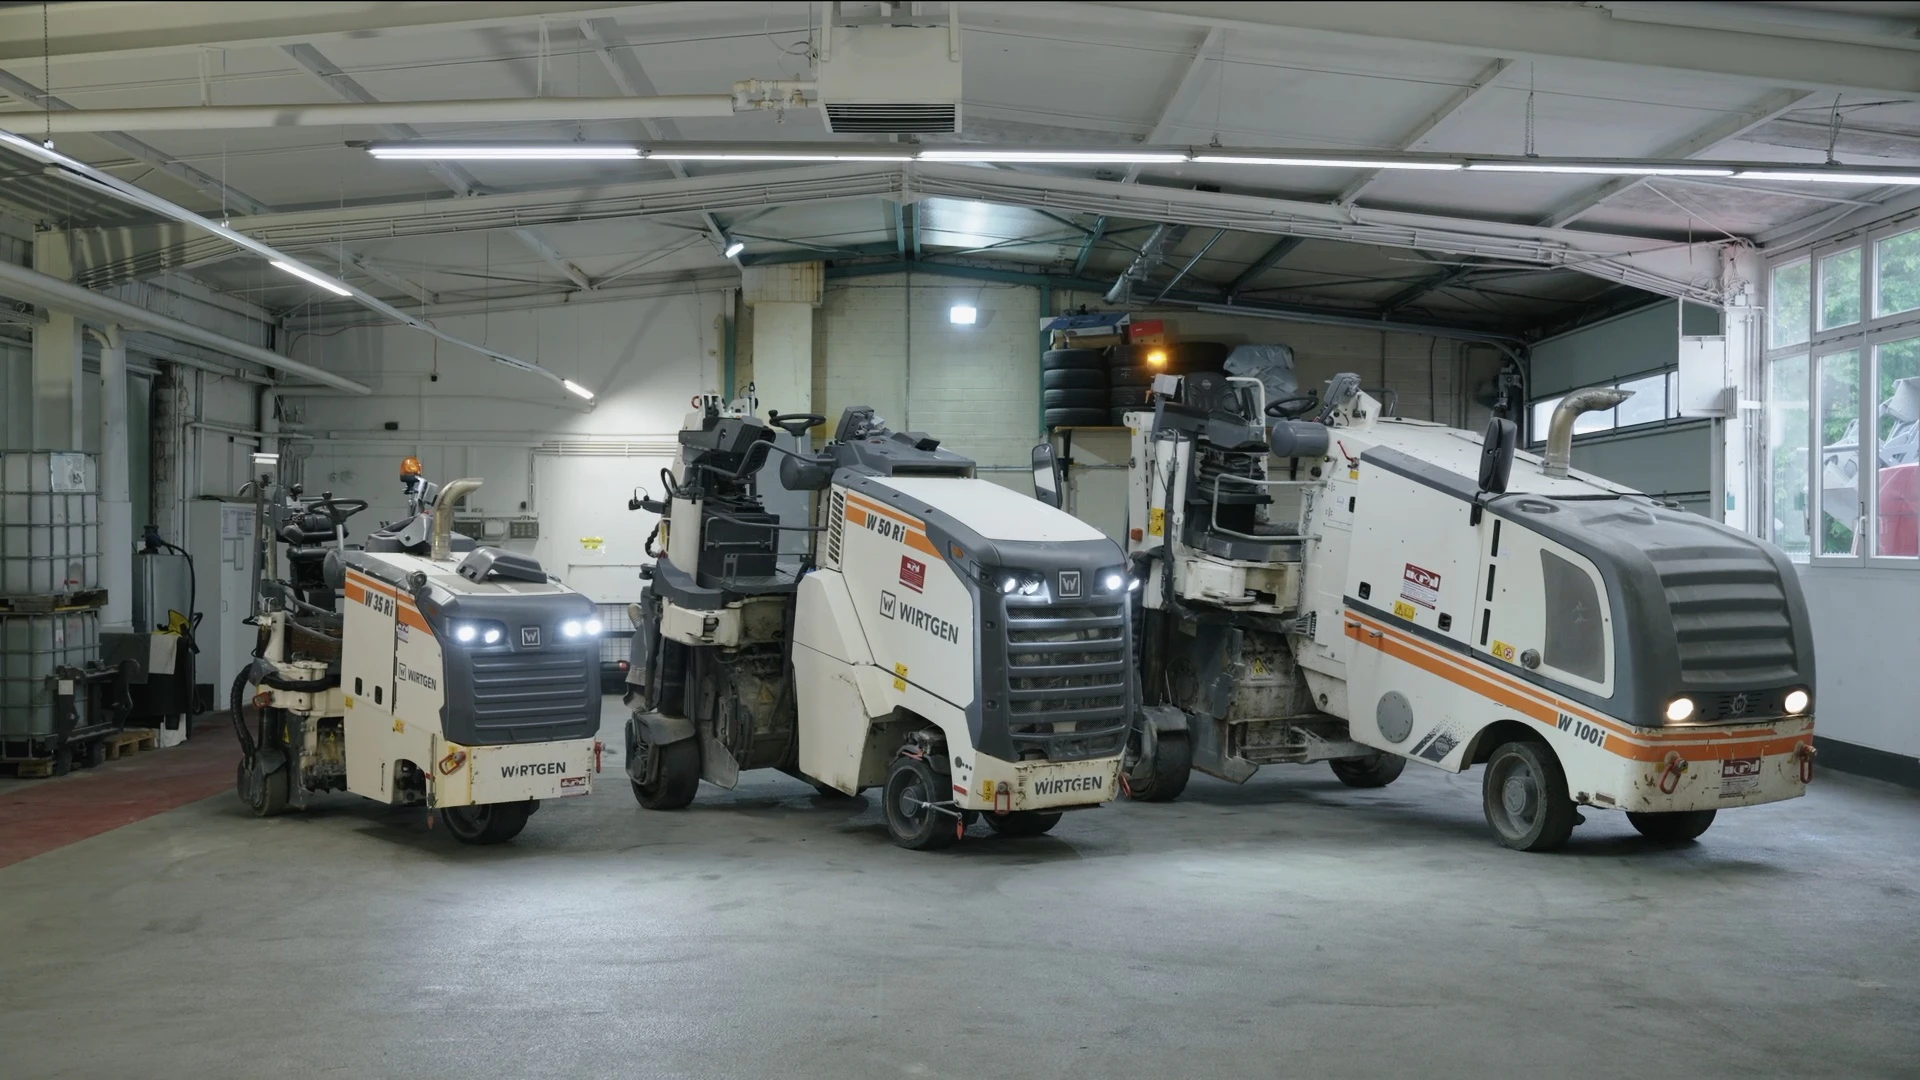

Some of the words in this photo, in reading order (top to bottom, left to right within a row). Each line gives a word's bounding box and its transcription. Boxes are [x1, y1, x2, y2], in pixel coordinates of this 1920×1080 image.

[867, 513, 877, 531] W
[877, 518, 891, 536] 50
[892, 525, 905, 543] Ri
[365, 590, 374, 607] W
[373, 594, 384, 613] 35
[384, 599, 394, 617] Ri
[900, 602, 959, 644] WIRTGEN
[407, 668, 437, 691] WIRTGEN
[1558, 713, 1573, 732] W
[1574, 721, 1606, 747] 100i
[501, 762, 566, 778] WIRTGEN
[1035, 776, 1102, 795] WIRTGEN
